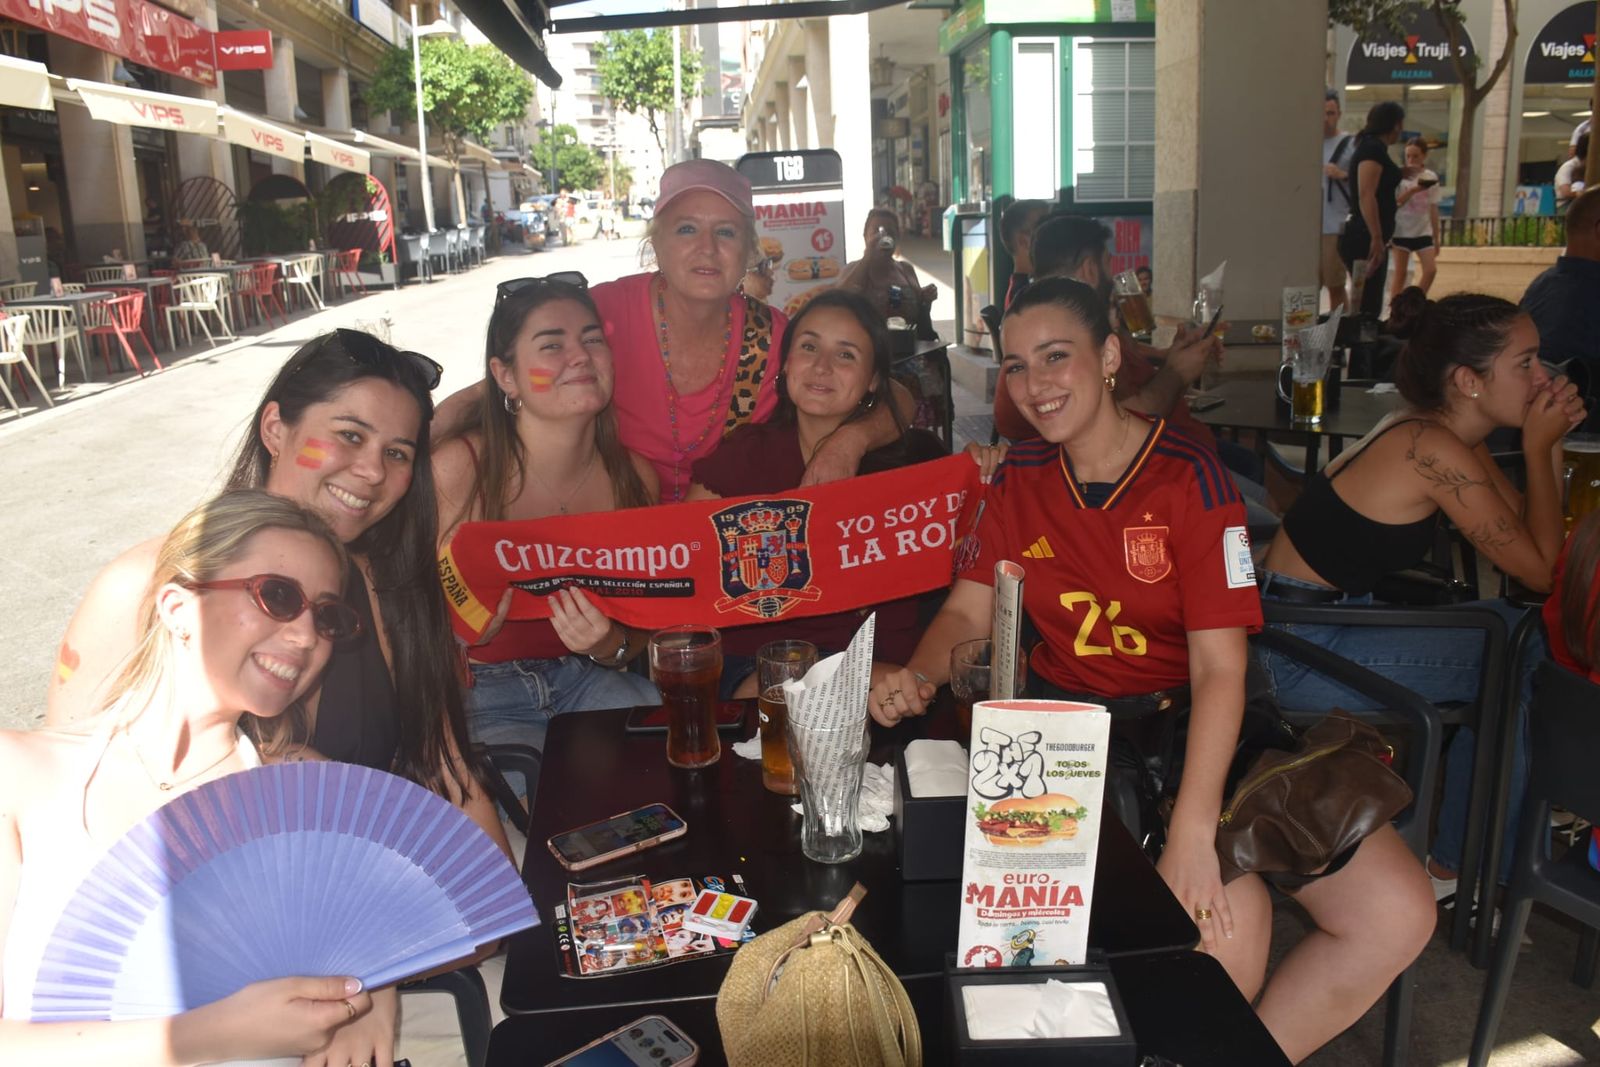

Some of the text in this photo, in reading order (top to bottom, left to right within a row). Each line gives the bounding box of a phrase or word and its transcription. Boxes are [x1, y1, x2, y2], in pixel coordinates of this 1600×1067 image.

[220, 45, 266, 55] VIPS
[1363, 42, 1466, 60] Viajes Trujio
[1541, 42, 1585, 60] Viajes
[130, 100, 185, 126] VIPS
[251, 128, 285, 152] VIPS
[330, 150, 355, 168] VIPS
[773, 155, 805, 182] TGB
[720, 504, 805, 522] 19 09
[836, 514, 875, 539] YO
[884, 497, 938, 528] SOY
[494, 539, 690, 577] Cruzcampo
[838, 537, 886, 569] LA
[439, 556, 468, 608] ESPAÑA
[602, 580, 646, 588] SELECCIÓN
[1060, 591, 1147, 656] 26
[980, 727, 1042, 763] THE
[1046, 743, 1095, 752] THEGOODBURGER
[1046, 770, 1064, 778] LOS
[1003, 873, 1050, 884] euro
[965, 880, 1084, 908] MANÍA
[981, 909, 1020, 919] Domingos
